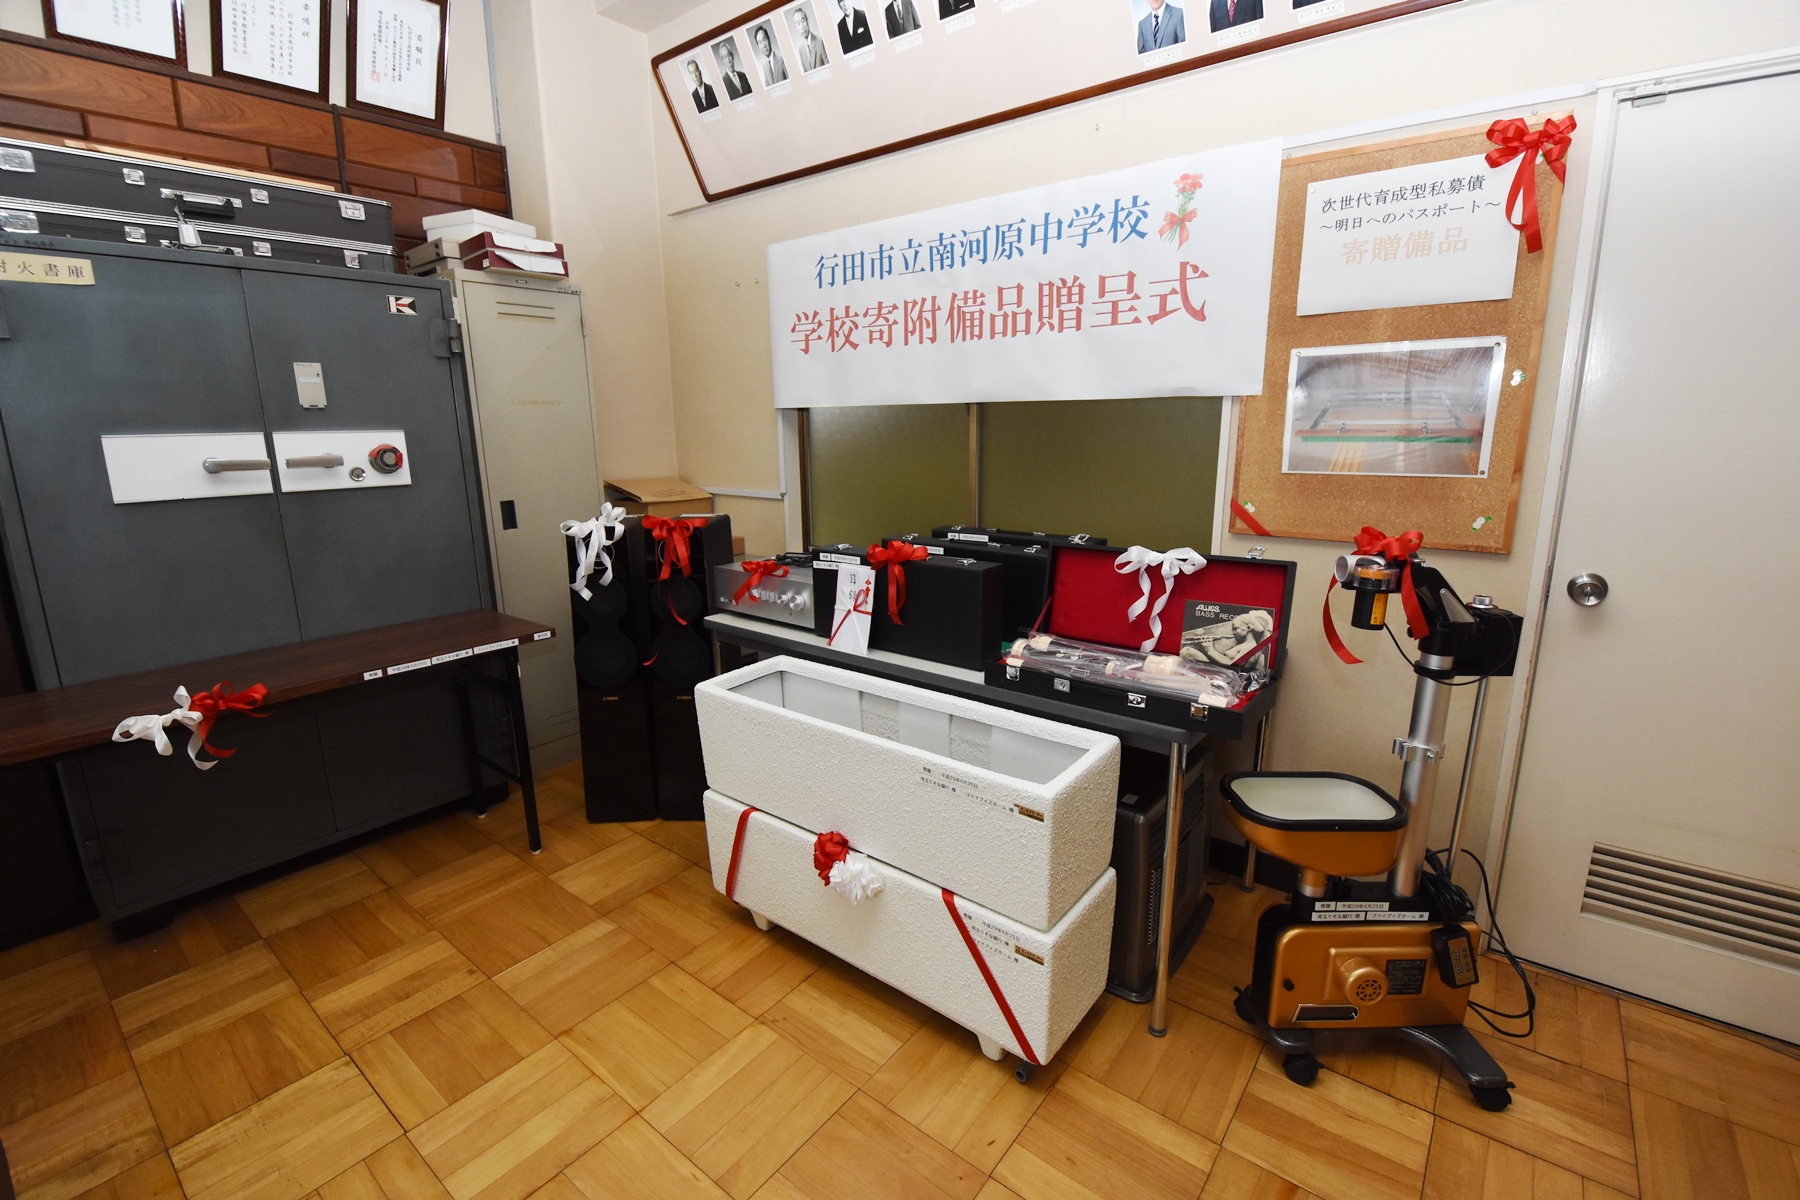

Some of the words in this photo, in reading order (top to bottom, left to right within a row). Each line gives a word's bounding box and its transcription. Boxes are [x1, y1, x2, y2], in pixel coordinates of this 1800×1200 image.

[1321, 174, 1486, 214] 次世代育成型私募債
[814, 195, 1151, 290] 行田市立南河原中学校
[1340, 226, 1468, 265] 寄贈備品
[790, 261, 1209, 355] 学校寄附備品贈呈式
[1196, 610, 1215, 618] BASS
